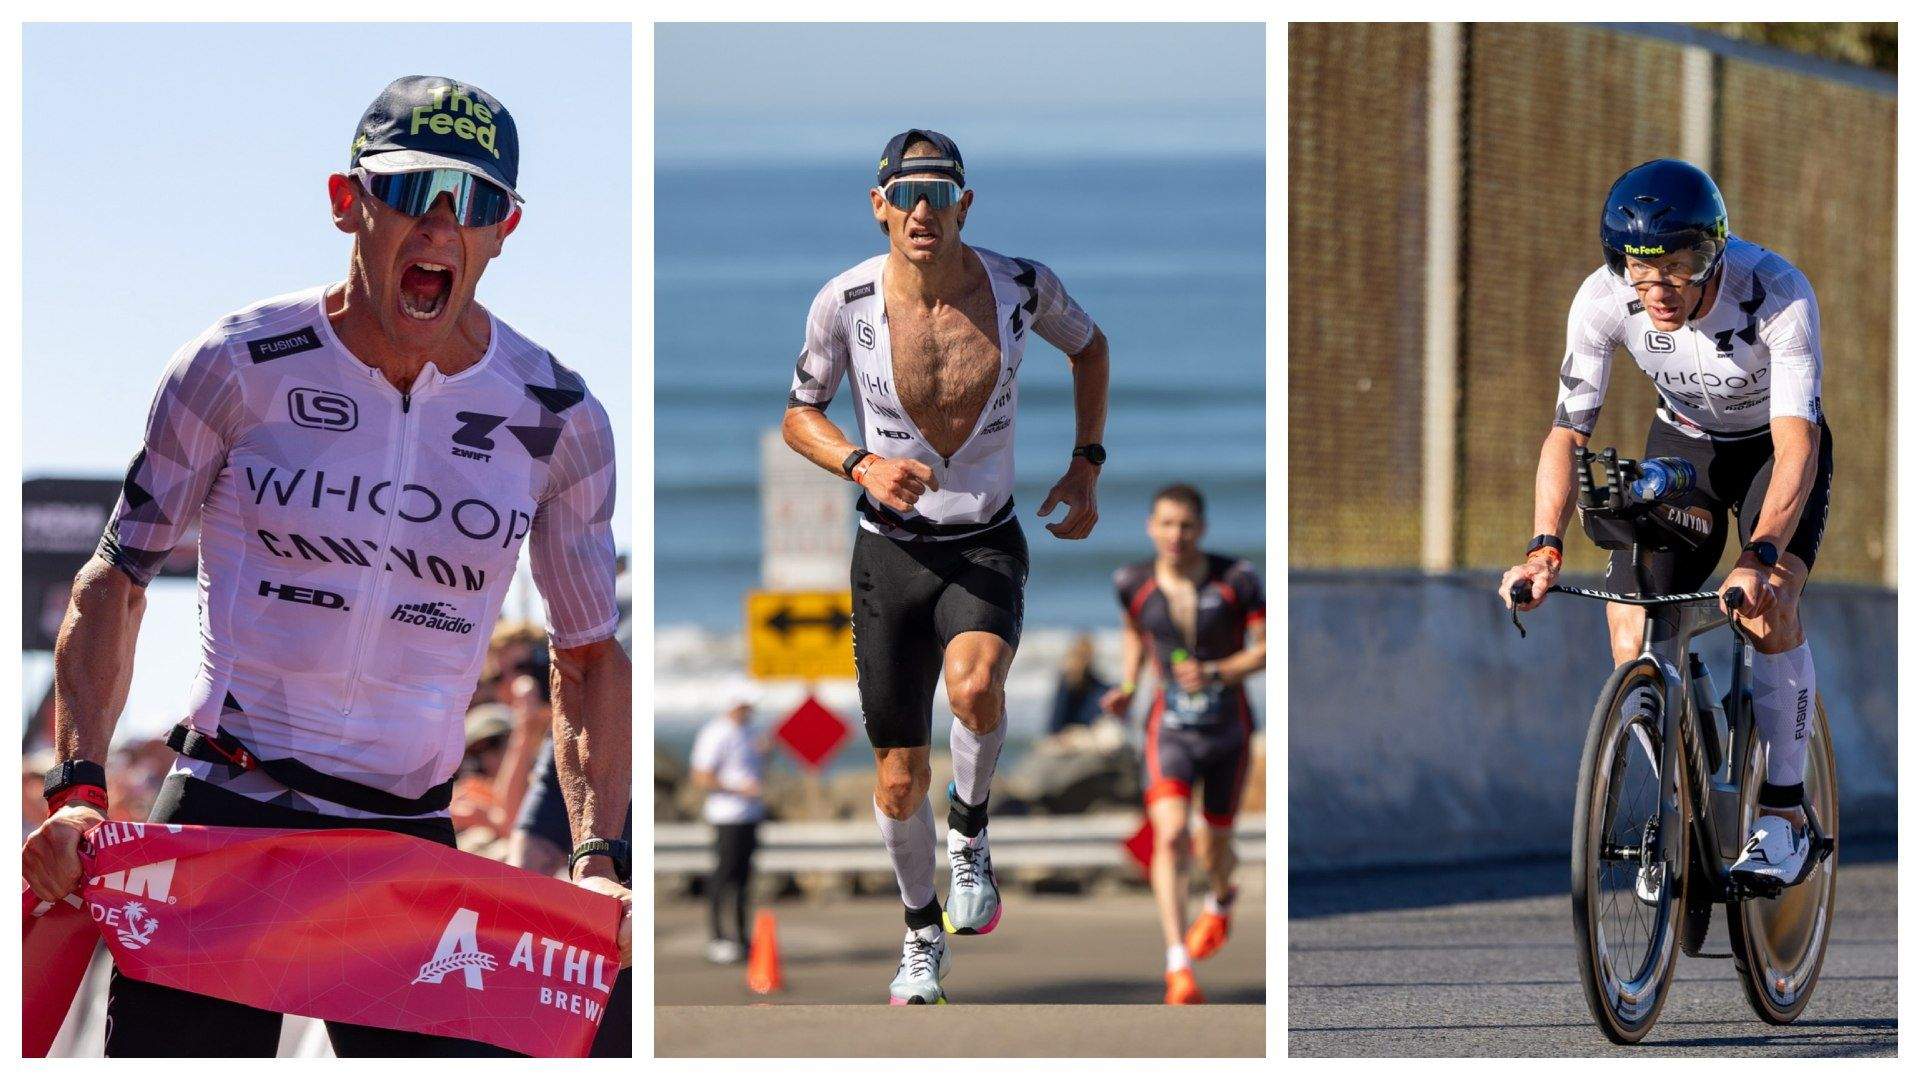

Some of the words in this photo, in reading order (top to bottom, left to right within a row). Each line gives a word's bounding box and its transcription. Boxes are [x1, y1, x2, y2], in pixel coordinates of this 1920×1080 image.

[428, 85, 493, 124] The
[410, 105, 500, 160] Feed.
[1624, 244, 1639, 255] The
[259, 333, 310, 356] FUSION
[451, 446, 492, 463] ZWIFT
[246, 466, 530, 549] WHOOP
[1668, 508, 1709, 535] CANYON
[257, 529, 485, 591] CANYON
[1795, 688, 1808, 741] FUSION
[509, 931, 610, 993] ATHL
